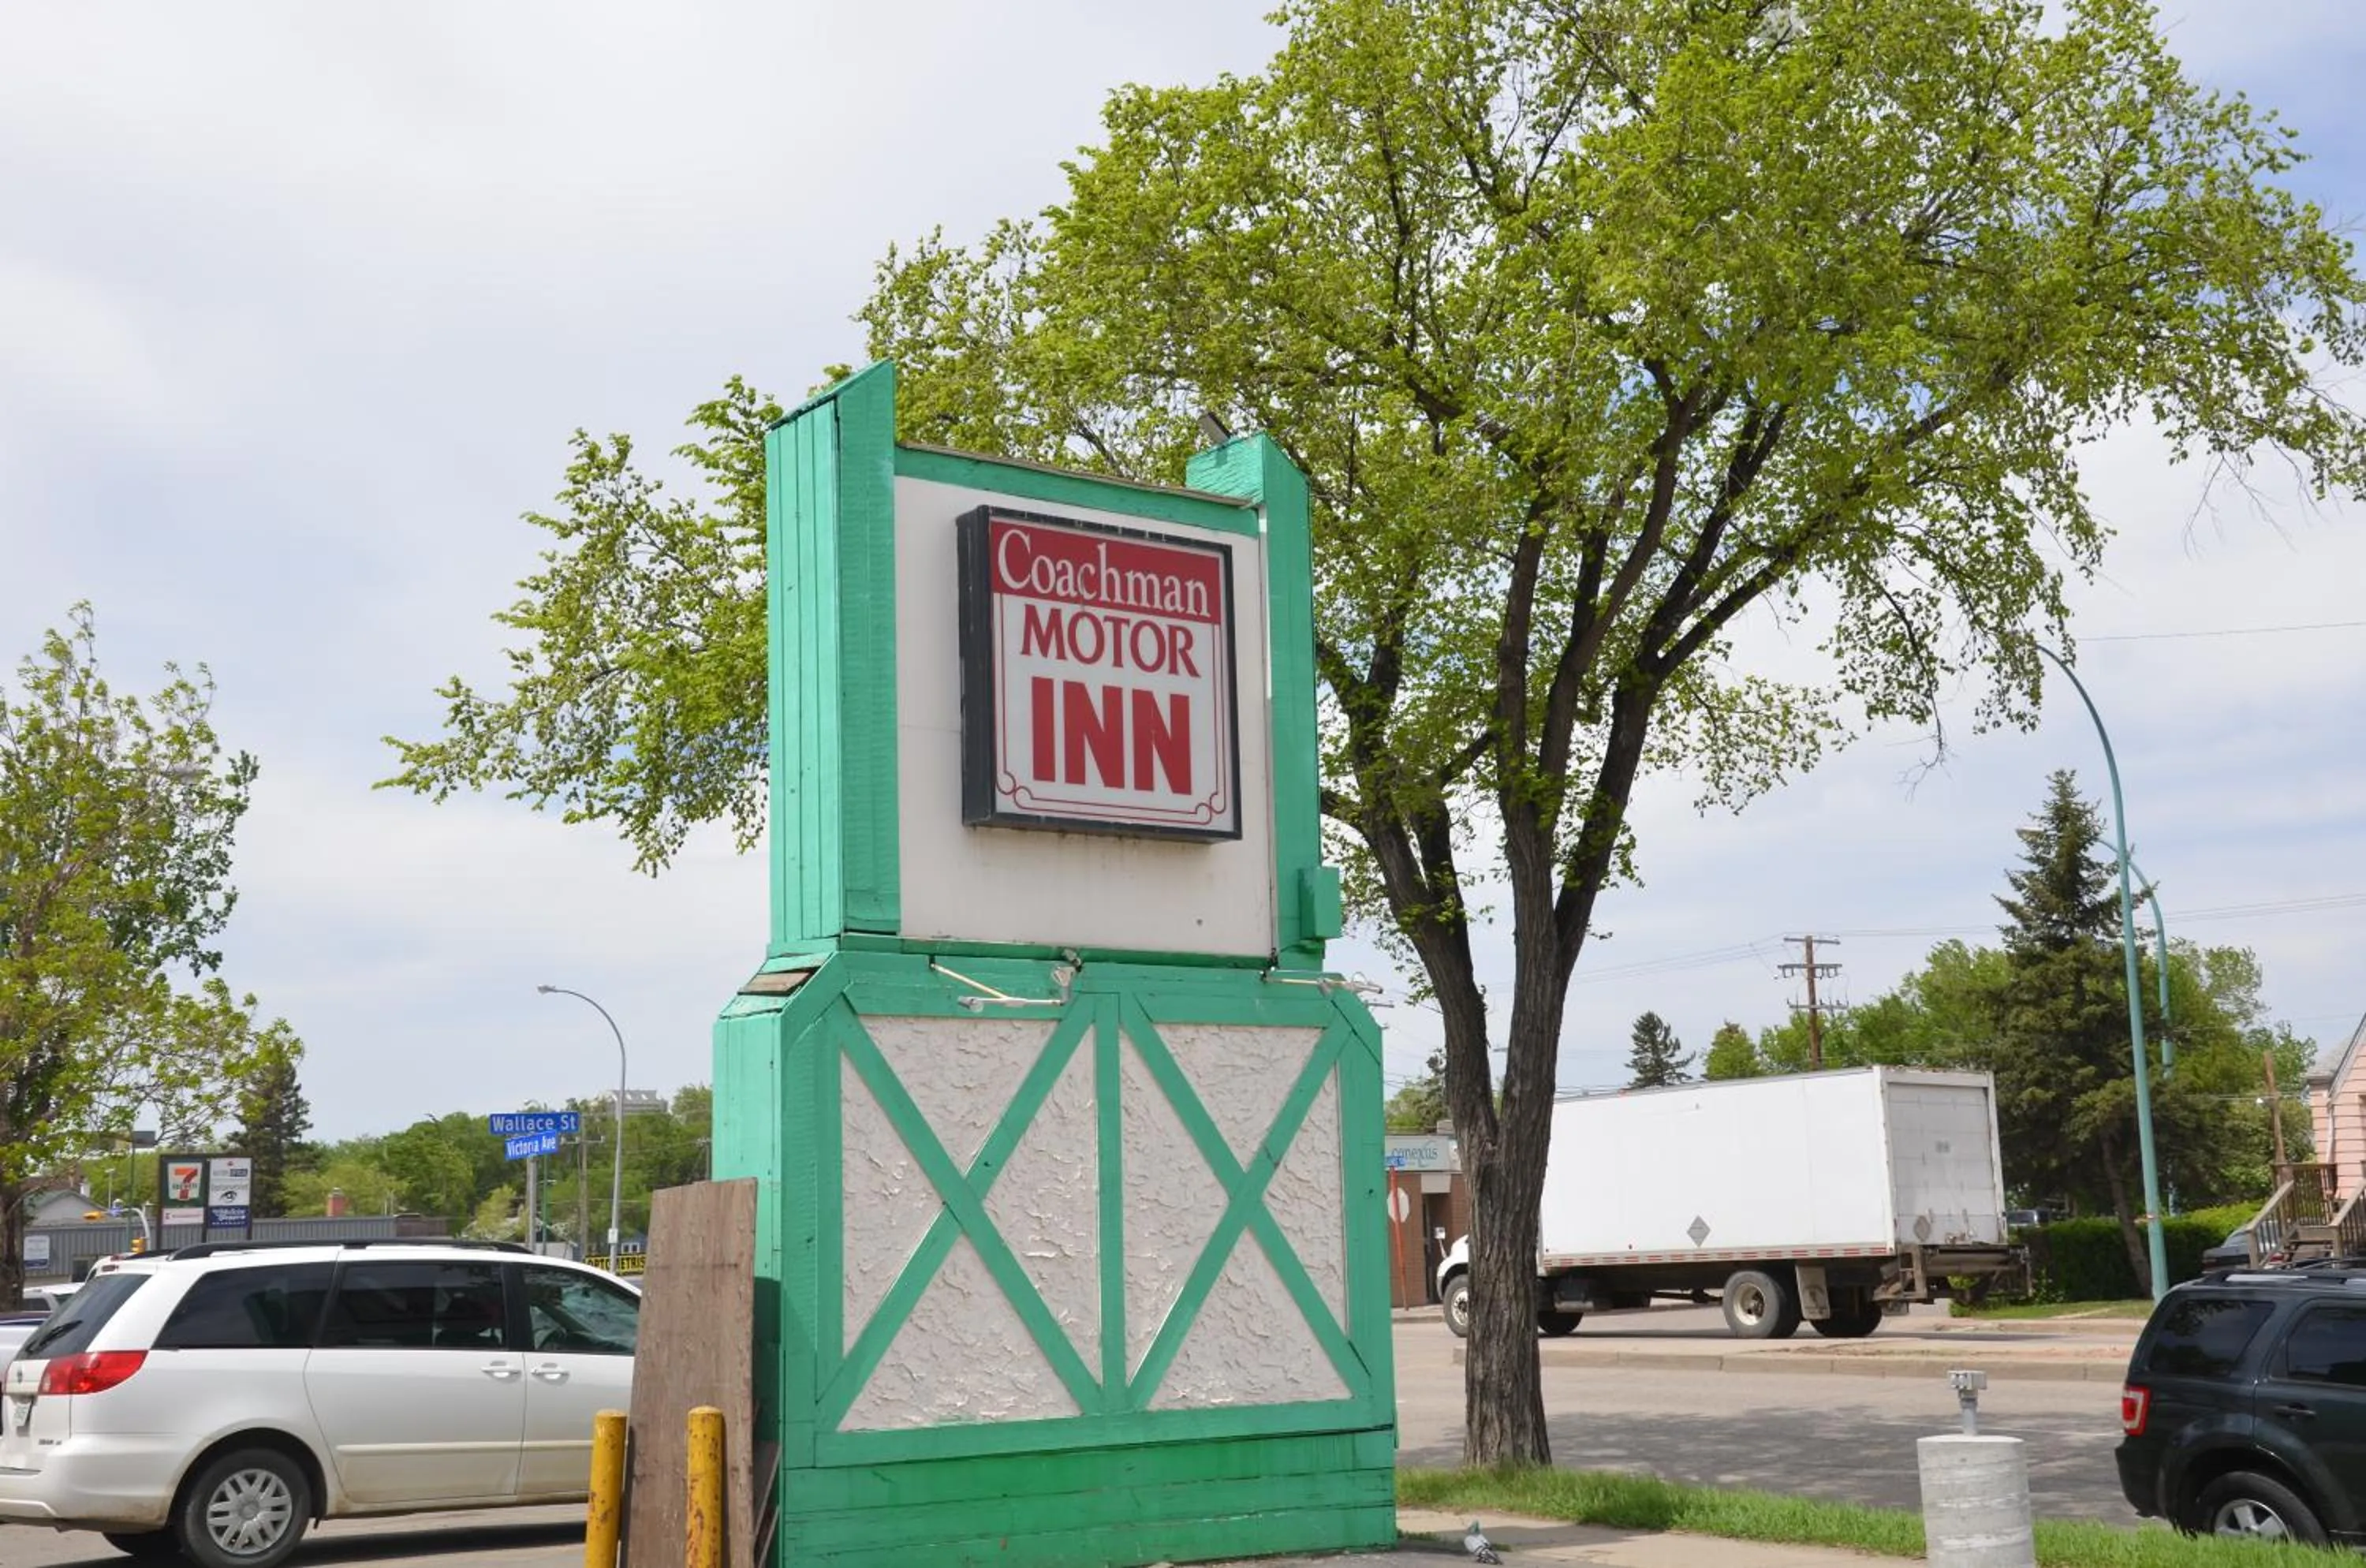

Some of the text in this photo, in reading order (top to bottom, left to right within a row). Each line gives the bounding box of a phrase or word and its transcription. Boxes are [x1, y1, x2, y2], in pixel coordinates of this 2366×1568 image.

[998, 529, 1211, 618] Coachman
[1021, 604, 1201, 678] MOTOR
[1032, 676, 1192, 796] INN
[491, 1114, 577, 1132] Wallace St
[506, 1135, 556, 1159] Victoria Ave
[174, 1167, 198, 1199] 7
[587, 1254, 646, 1270] OPTOETRIS
